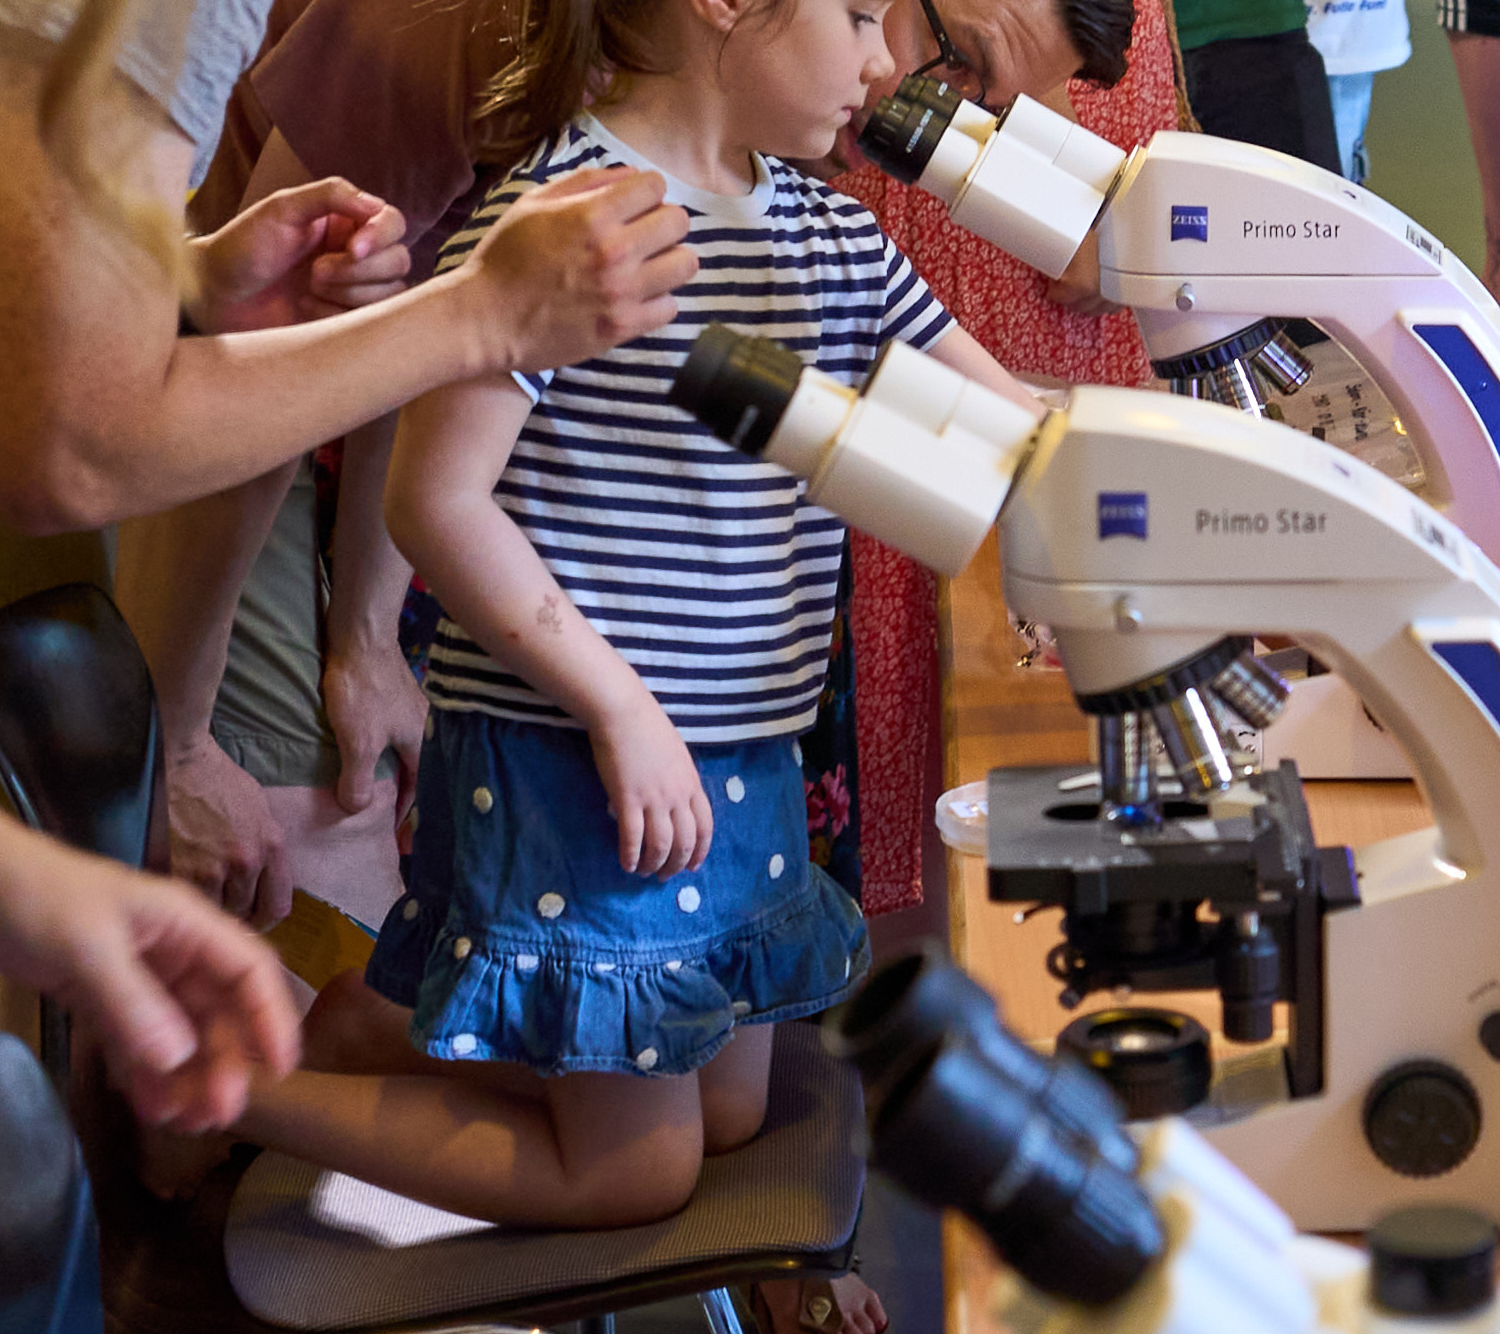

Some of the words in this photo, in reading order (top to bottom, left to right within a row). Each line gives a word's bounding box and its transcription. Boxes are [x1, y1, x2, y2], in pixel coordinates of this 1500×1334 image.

[1243, 220, 1297, 239] Primo
[1303, 220, 1342, 239] Star
[1195, 509, 1270, 534] Primo
[1276, 509, 1328, 534] Star
